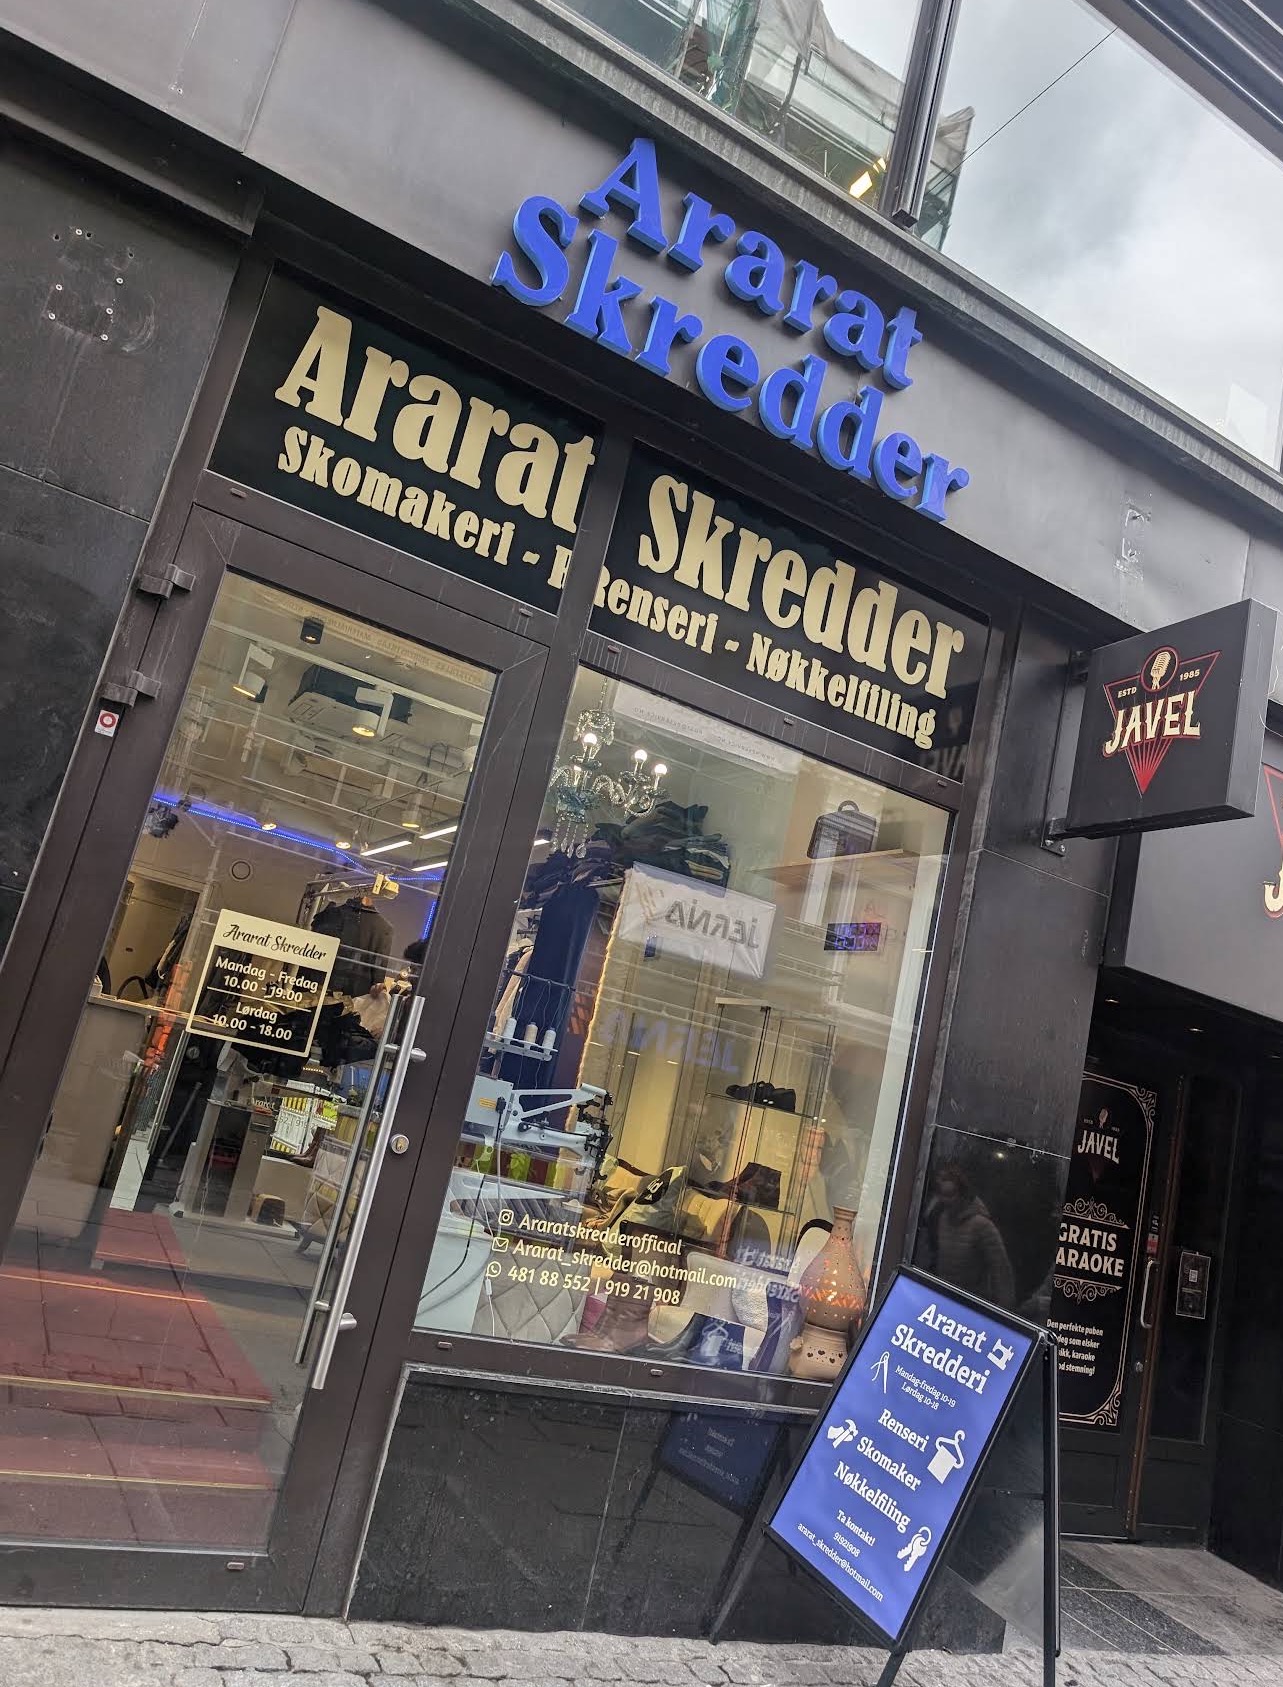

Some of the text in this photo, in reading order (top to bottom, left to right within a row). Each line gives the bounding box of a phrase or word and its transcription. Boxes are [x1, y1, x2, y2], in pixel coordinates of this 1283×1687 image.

[579, 138, 923, 390] Ararat
[491, 195, 969, 522] Skredder
[275, 306, 964, 699] Ararat Skredder
[278, 426, 515, 565] Skomakeri
[745, 632, 937, 750] Nøkkelfiling
[1117, 668, 1200, 698] ESTD 1985
[1105, 690, 1200, 754] JAVEL
[223, 924, 327, 961] Ararat Skredder
[215, 956, 267, 981] Mandag
[278, 971, 319, 993] Fredag
[224, 975, 258, 992] 10.00
[270, 985, 303, 1003] 19.00
[212, 1014, 247, 1031] 10.00
[259, 1024, 293, 1041] 18.00
[235, 1002, 278, 1024] Lørdag
[1077, 1129, 1120, 1165] JAVEL
[518, 1213, 682, 1256] Araratskredderofficial
[1059, 1222, 1118, 1252] GRATIS
[512, 1238, 737, 1289] Ararat_skredder@hotmail.com
[1056, 1247, 1125, 1278] ARAOKE
[507, 1264, 535, 1284] 481
[539, 1269, 558, 1287] 88
[563, 1273, 590, 1291] 552
[604, 1280, 629, 1298] 919
[633, 1284, 650, 1300] 21
[653, 1287, 681, 1304] 908
[917, 1303, 988, 1353] Ararat
[1046, 1319, 1058, 1329] Den
[1059, 1322, 1085, 1334] perfekte
[1068, 1338, 1081, 1346] som
[890, 1324, 990, 1394] Skredderi
[1065, 1363, 1095, 1376] stemning!
[1071, 1350, 1095, 1361] karaoke
[894, 1364, 956, 1408] Mandag-fredag 10-19
[901, 1382, 939, 1410] Lørdag 10-18
[878, 1408, 930, 1452] Renseri
[856, 1436, 921, 1491] Skomaker
[833, 1461, 911, 1534] Nøkkelfiling
[833, 1532, 861, 1558] 91921908
[836, 1509, 876, 1547] Ta kontakt!
[797, 1523, 884, 1602] ararat_skredder@hotmail.com
